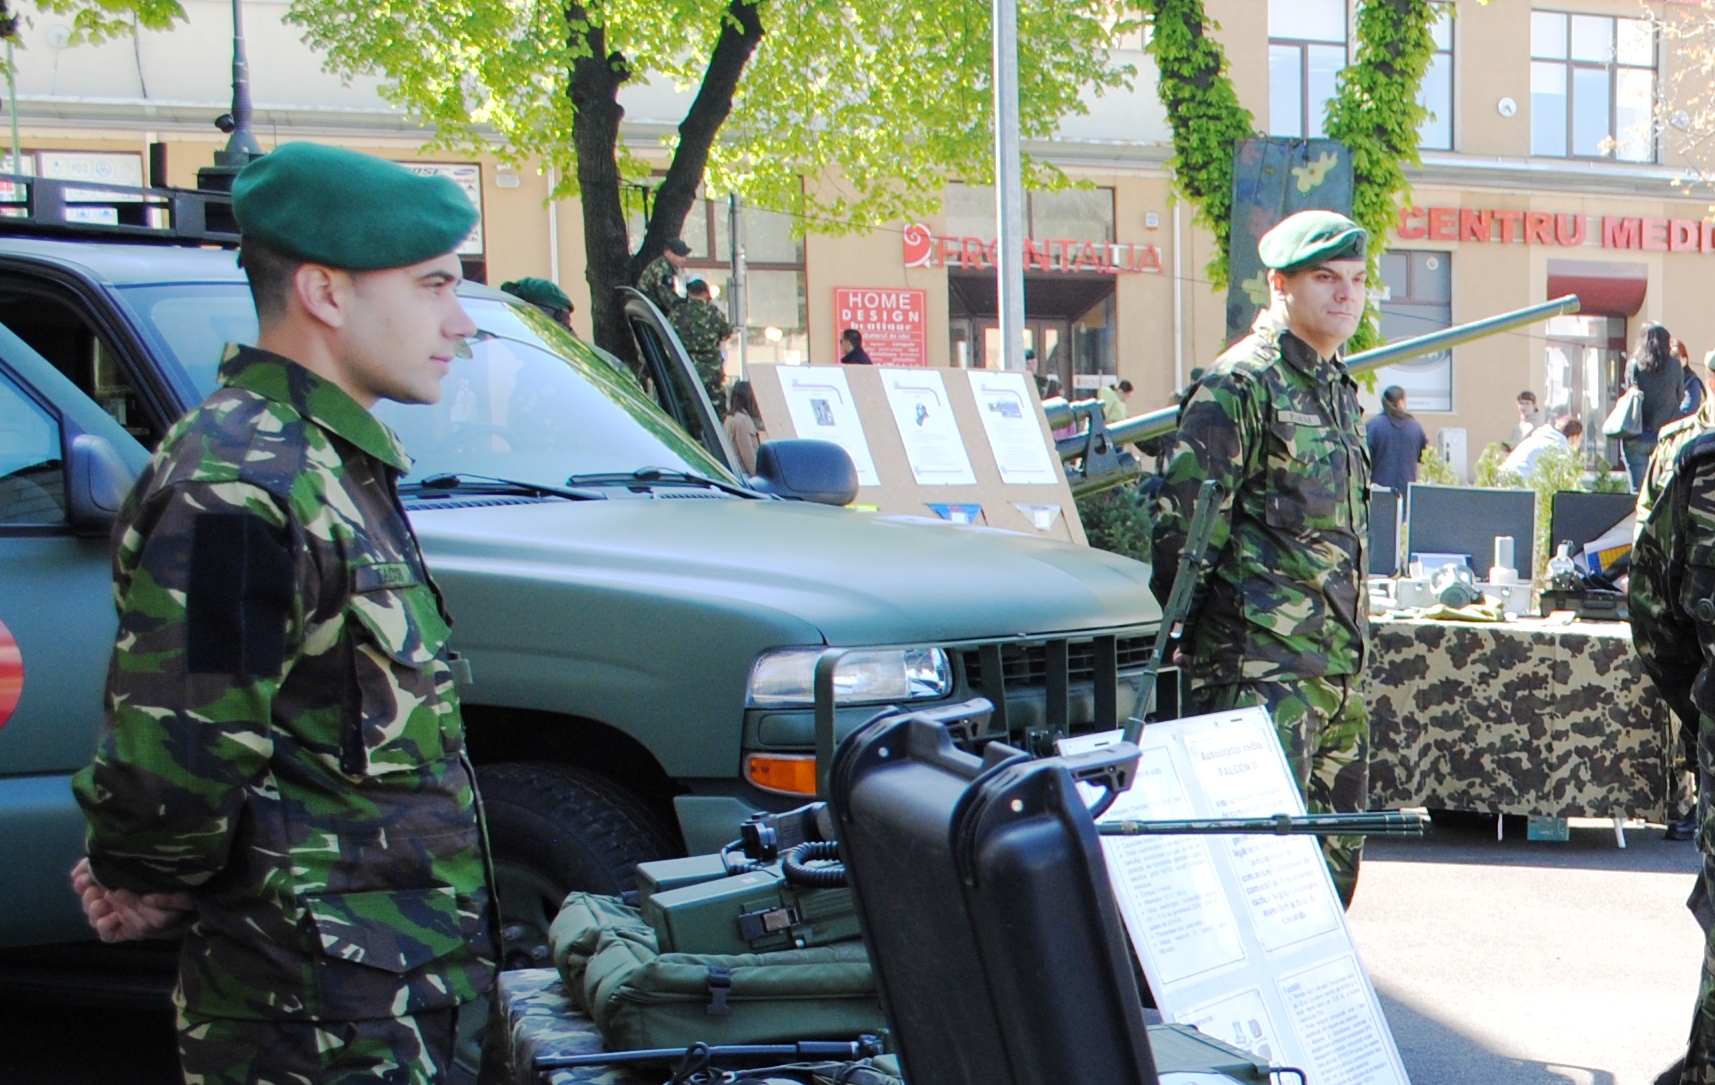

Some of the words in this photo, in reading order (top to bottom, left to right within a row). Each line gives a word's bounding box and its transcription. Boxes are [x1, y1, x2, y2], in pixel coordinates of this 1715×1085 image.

[1399, 205, 1587, 246] CENTRU
[848, 292, 911, 310] HOME
[841, 309, 919, 322] DESIGN
[1217, 763, 1252, 777] FALCON
